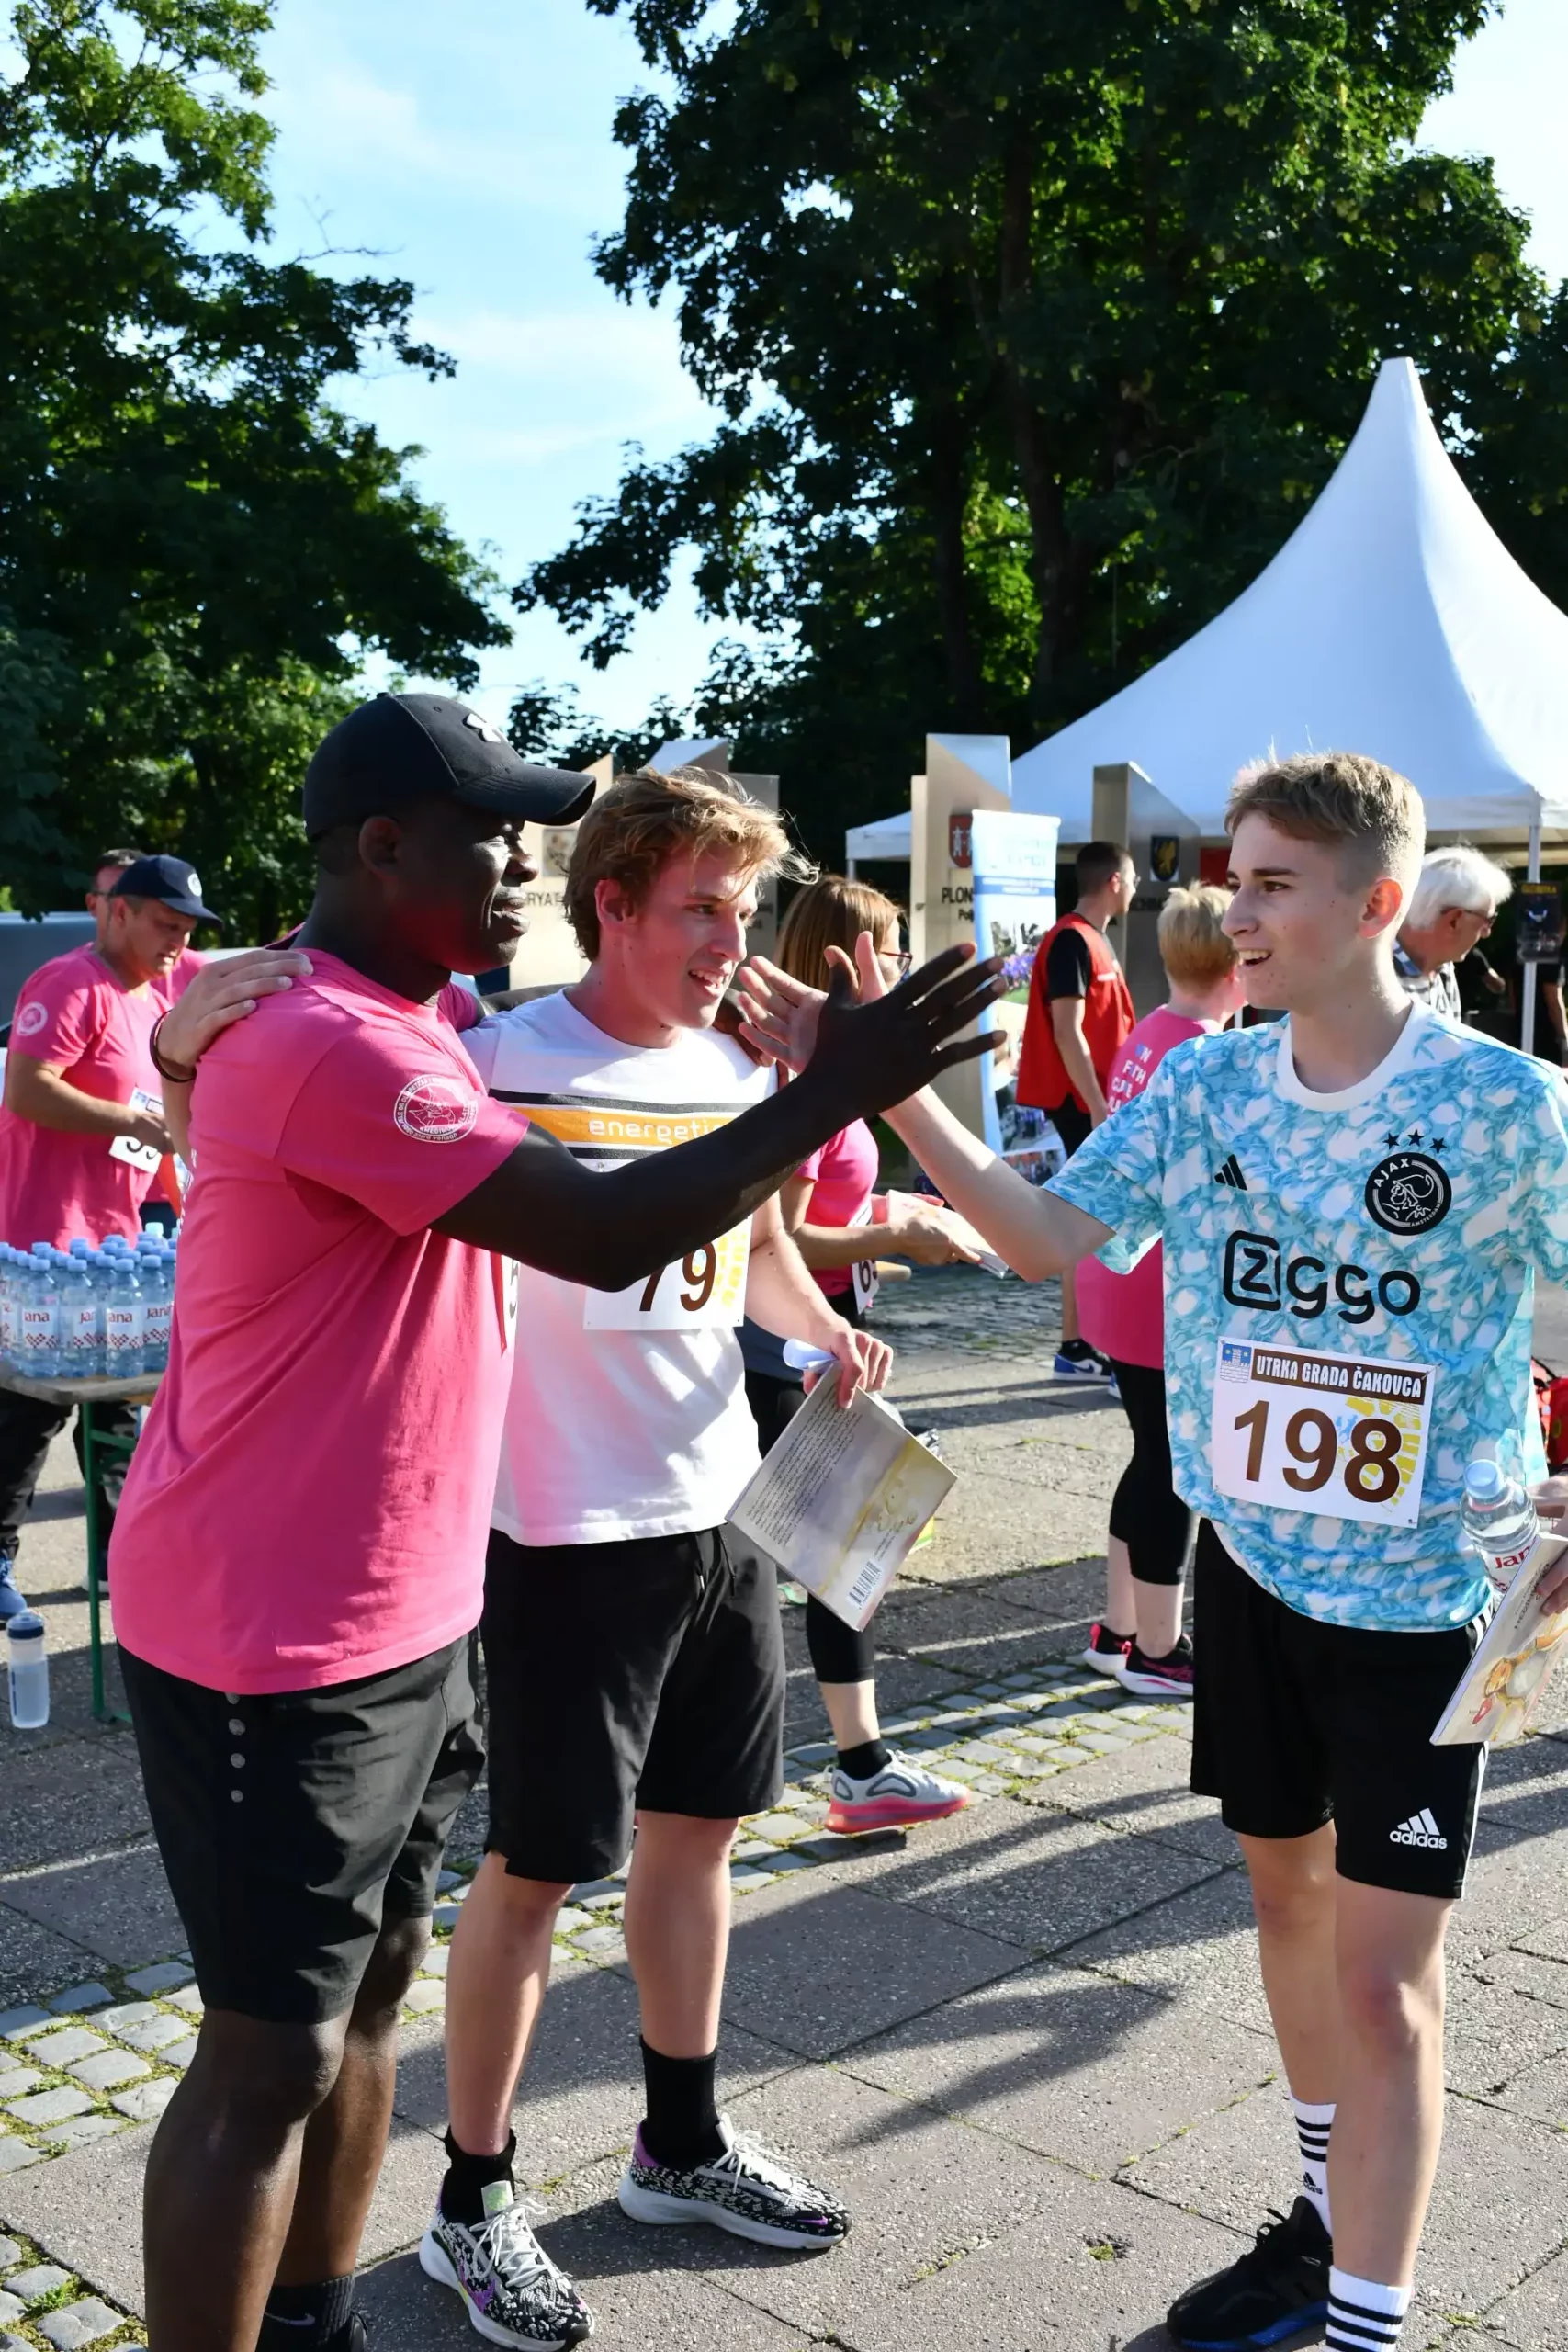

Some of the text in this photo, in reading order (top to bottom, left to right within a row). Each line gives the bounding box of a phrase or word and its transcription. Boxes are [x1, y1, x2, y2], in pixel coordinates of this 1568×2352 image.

[942, 887, 974, 905] PLON
[1373, 1158, 1410, 1187] AJAX
[1256, 1355, 1422, 1398] UTRKA GRADA ČAKOVCA
[1234, 1399, 1403, 1503] 198
[1389, 1829, 1449, 1849] adidas
